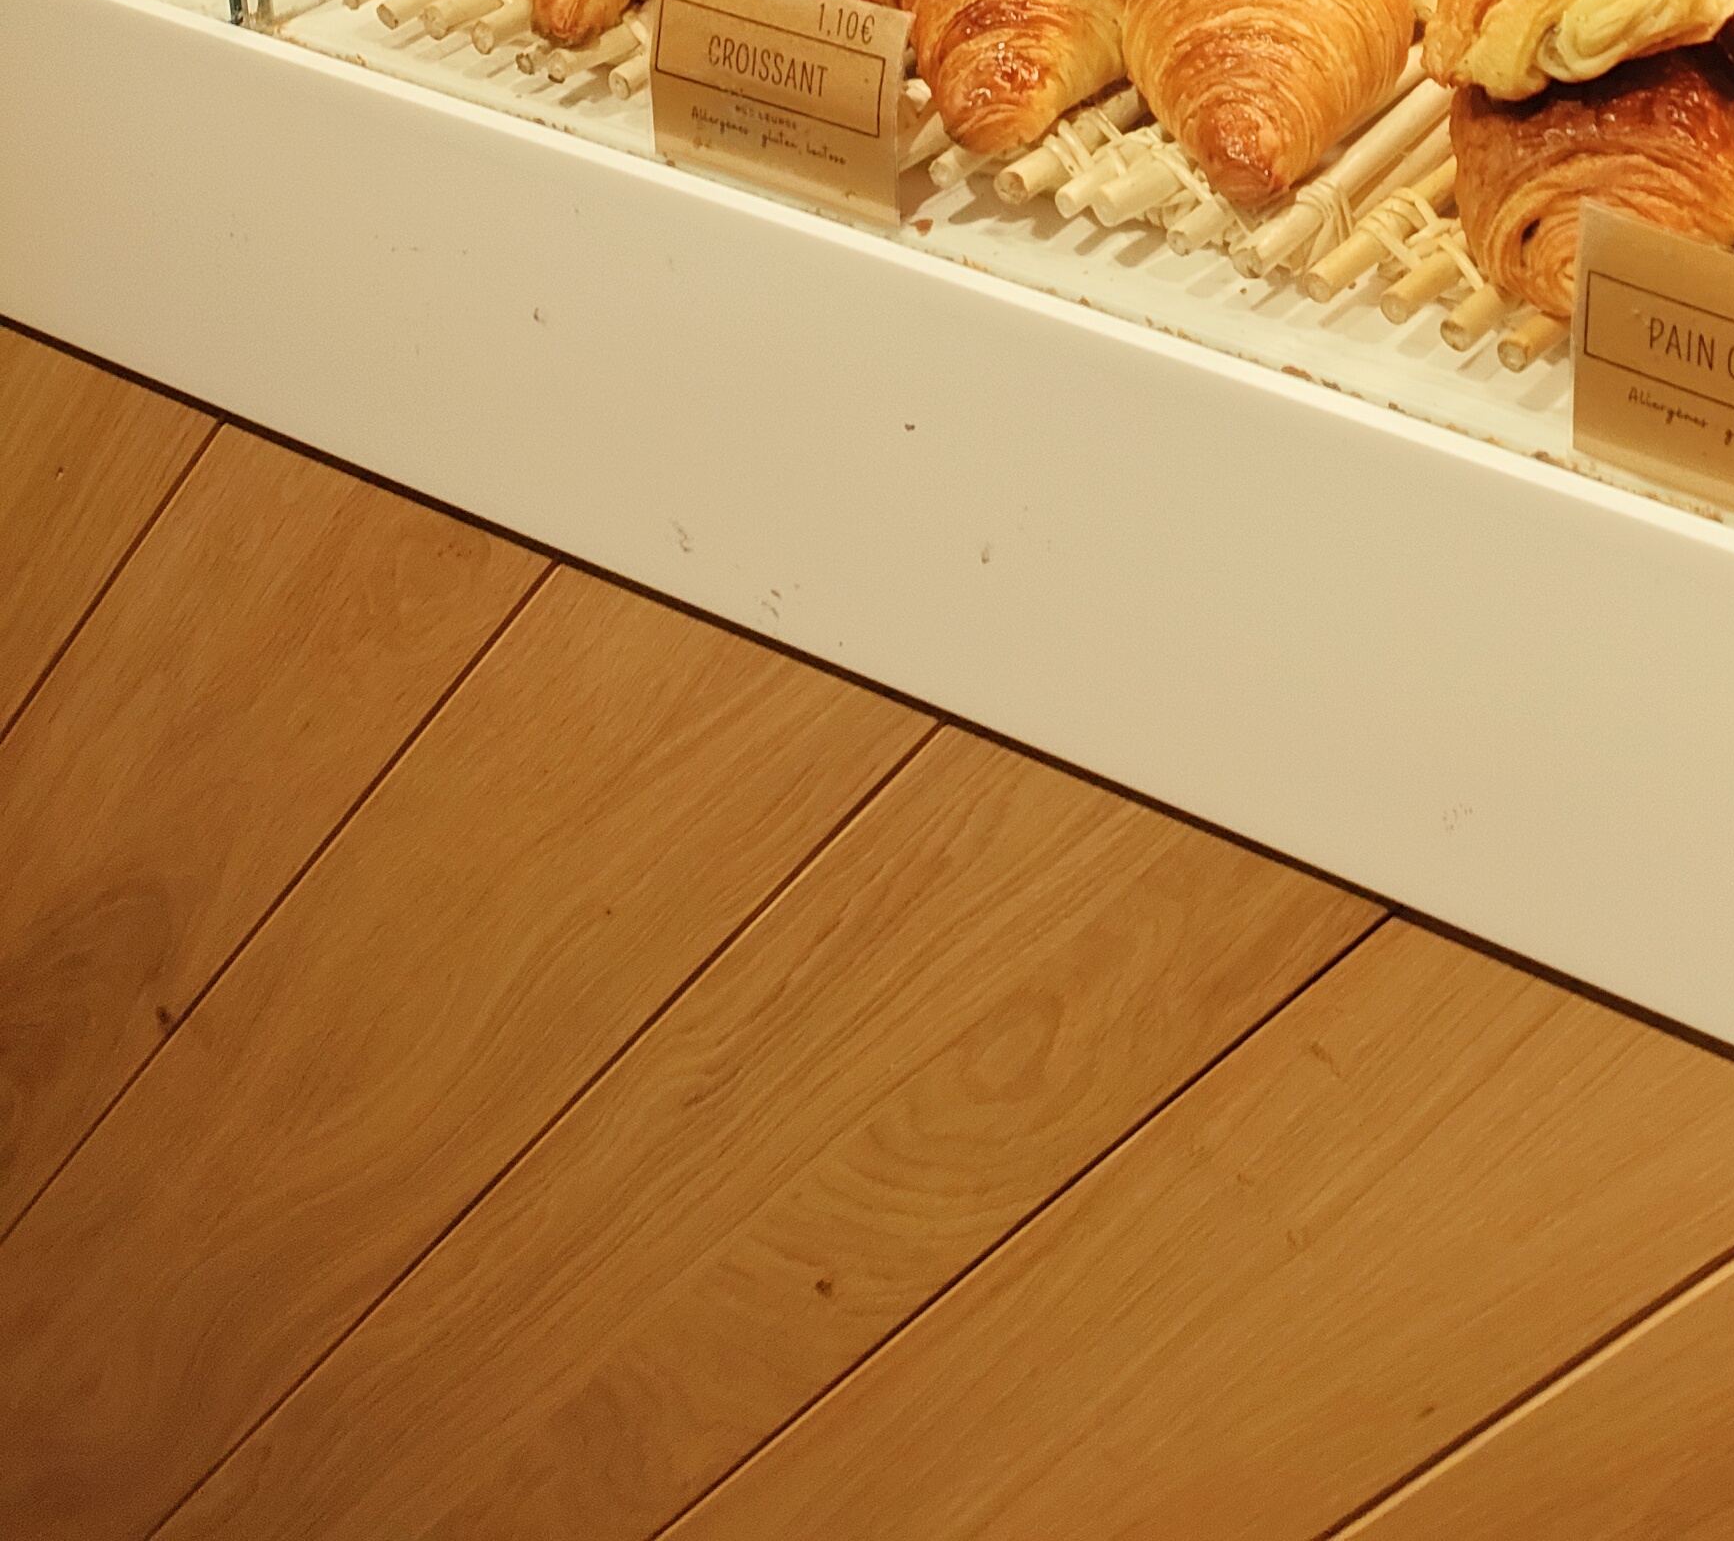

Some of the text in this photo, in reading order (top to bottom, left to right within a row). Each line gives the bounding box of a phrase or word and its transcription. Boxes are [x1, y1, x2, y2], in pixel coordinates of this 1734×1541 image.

[819, 3, 875, 45] 1,10€
[708, 34, 828, 98] CROISSANT
[1650, 318, 1715, 371] PAIN
